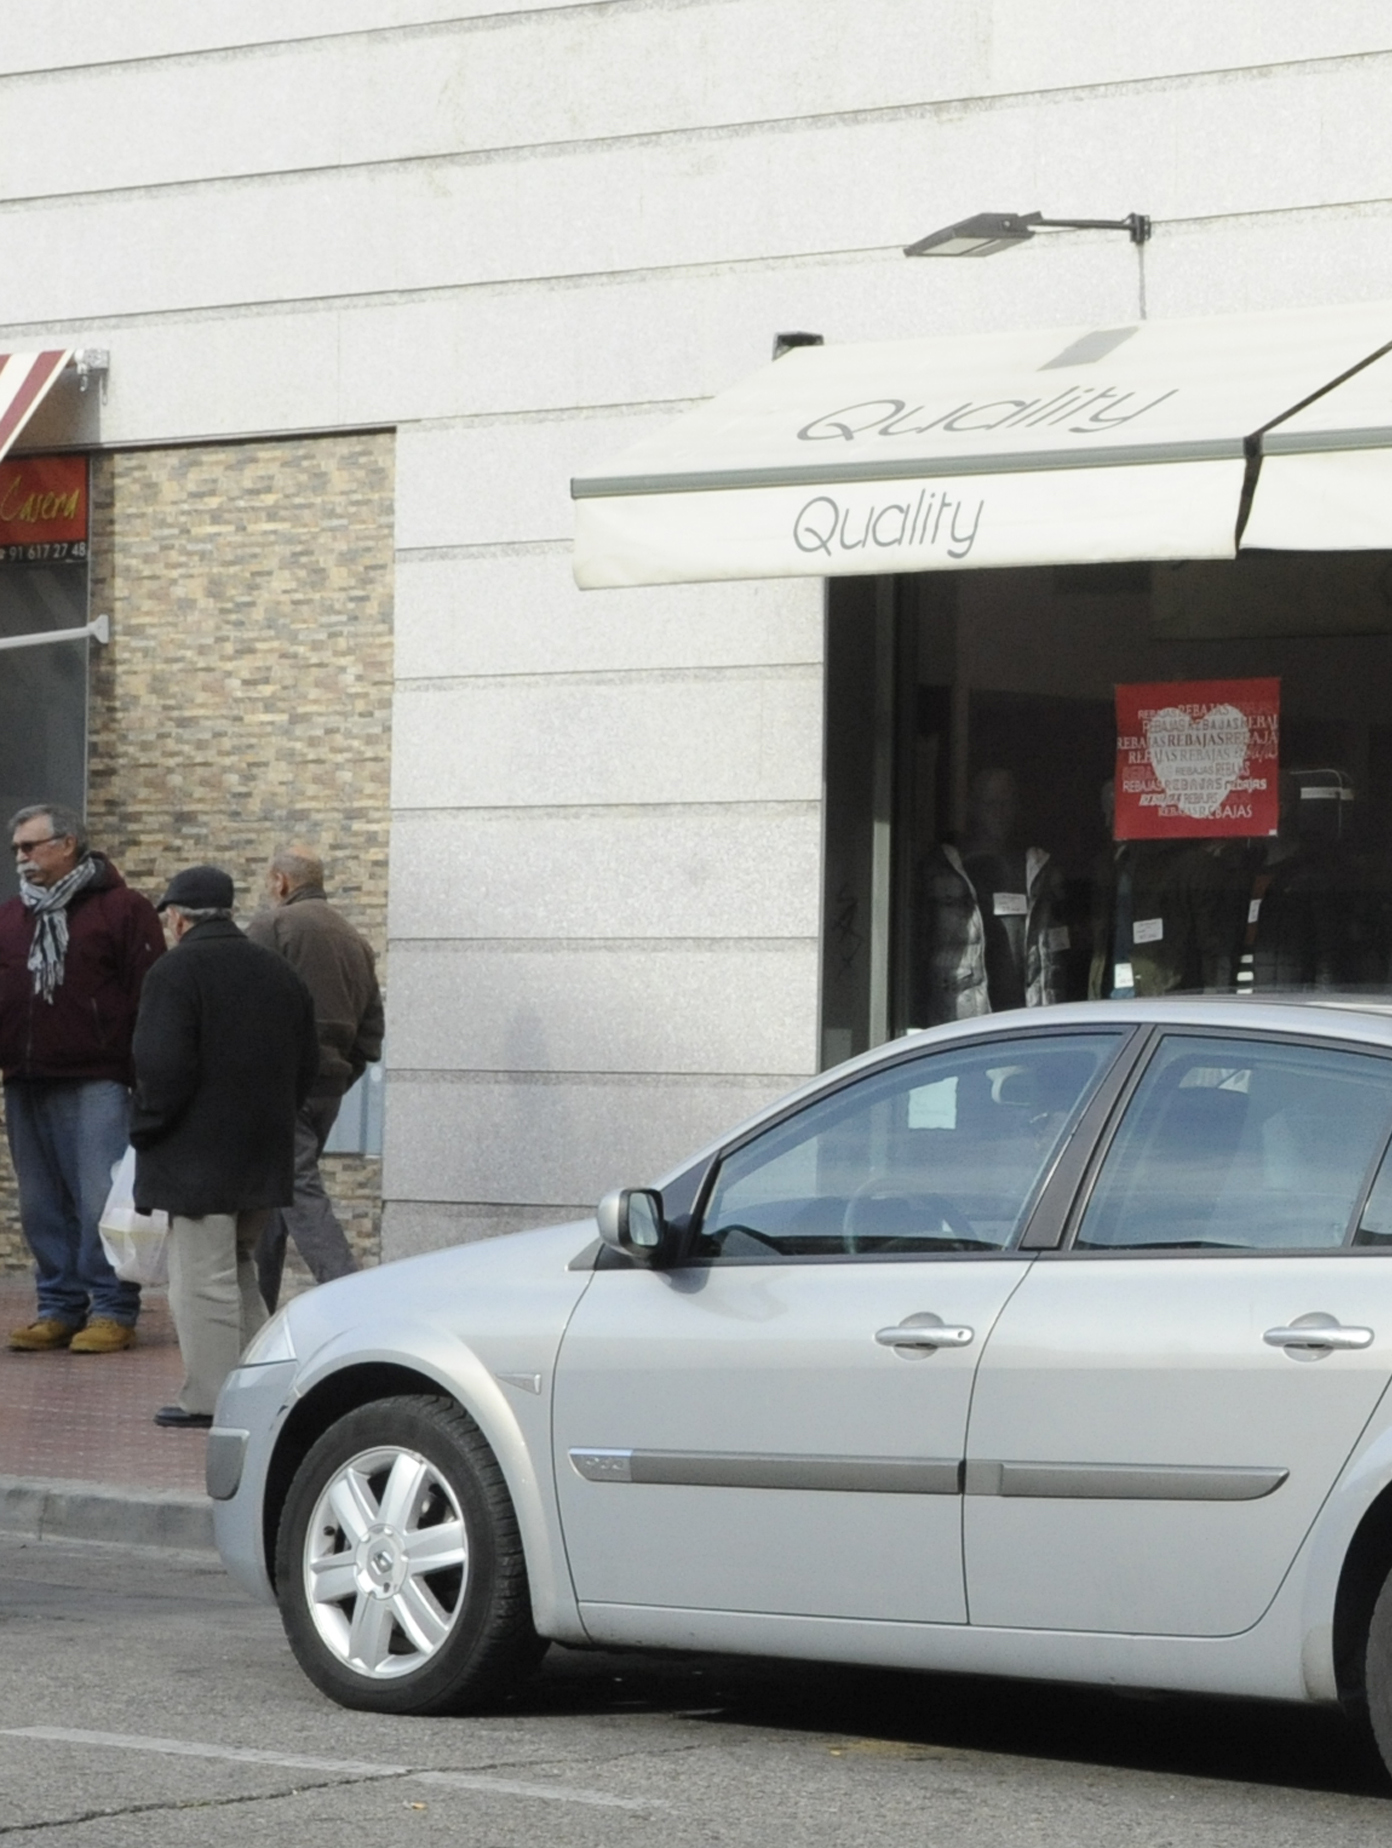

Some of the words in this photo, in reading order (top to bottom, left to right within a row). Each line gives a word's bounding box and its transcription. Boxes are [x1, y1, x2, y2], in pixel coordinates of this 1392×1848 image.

[797, 386, 1180, 441] Quality
[793, 488, 984, 559] Quality
[9, 546, 23, 561] 91
[28, 544, 50, 560] 617
[53, 543, 68, 558] 27
[71, 541, 86, 557] 48
[1167, 732, 1224, 748] REBAJAS
[1179, 745, 1230, 762] REBAJAS
